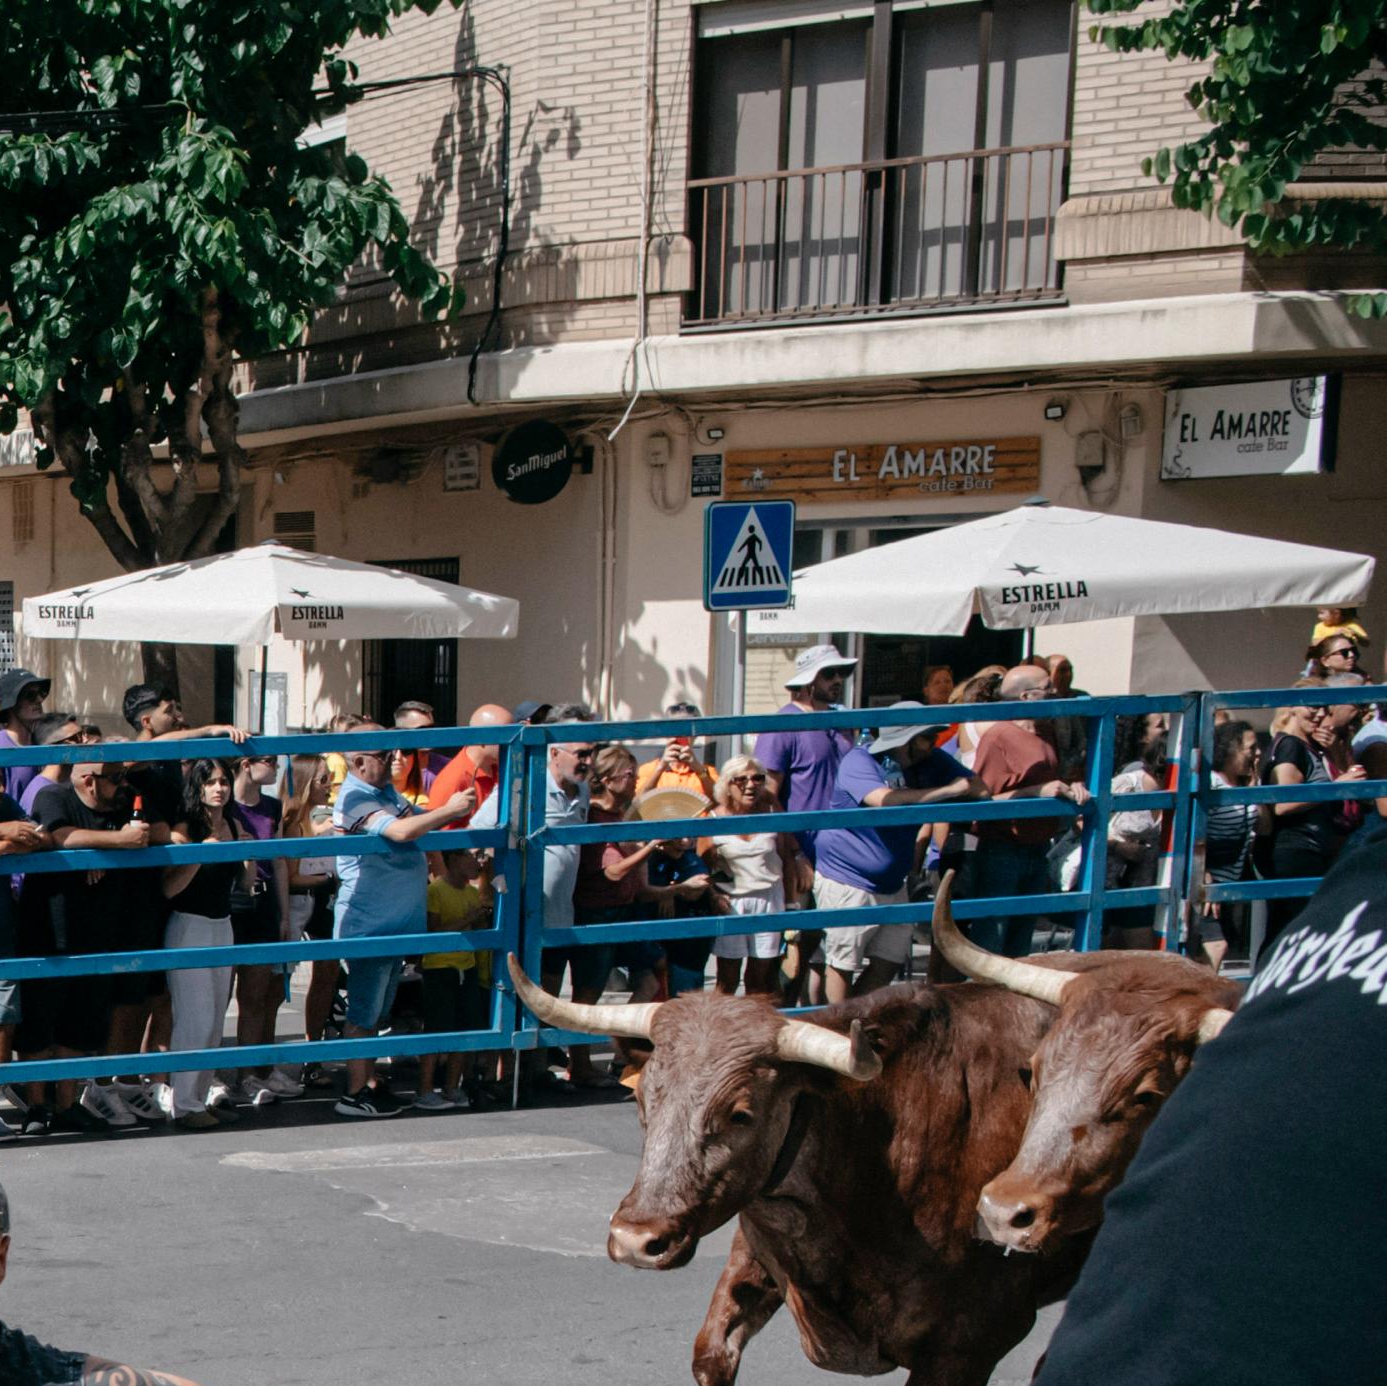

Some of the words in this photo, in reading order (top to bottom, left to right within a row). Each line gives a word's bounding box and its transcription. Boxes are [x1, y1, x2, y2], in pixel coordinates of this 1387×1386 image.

[1267, 437, 1289, 452] Bar
[962, 474, 995, 491] Bar
[1001, 580, 1088, 605] ESTRELLA
[38, 605, 95, 620] ESTRELLA
[291, 605, 345, 621] ESTRELLA
[1030, 601, 1060, 613] DAMM
